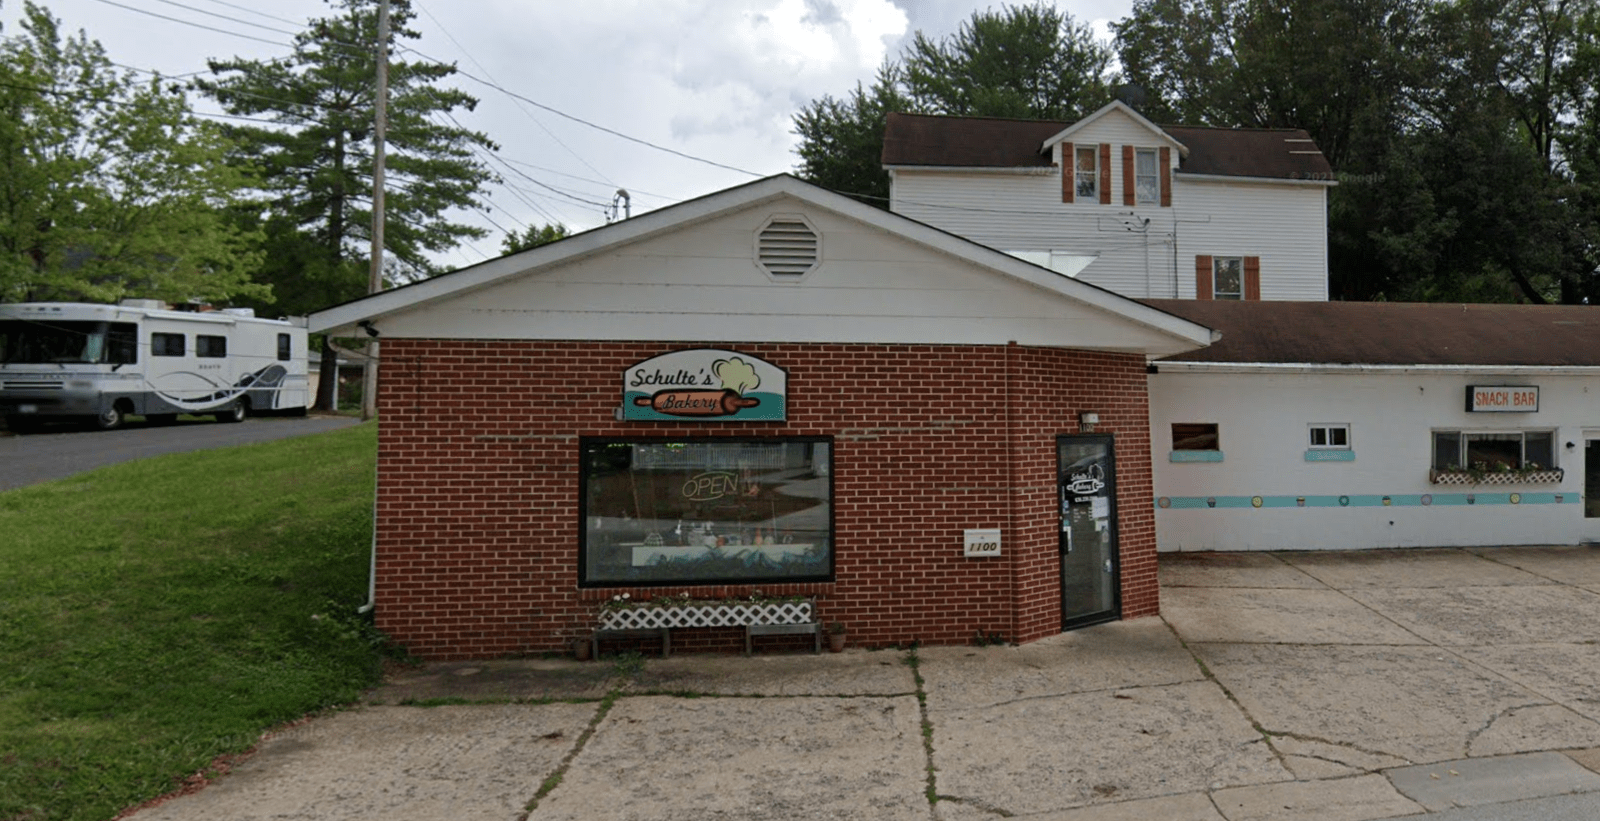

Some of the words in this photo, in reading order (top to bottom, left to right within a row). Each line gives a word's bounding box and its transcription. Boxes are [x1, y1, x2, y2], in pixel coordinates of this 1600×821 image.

[630, 368, 714, 387] Schulte's
[662, 394, 718, 411] Bakery
[1475, 391, 1509, 406] SNACK
[1514, 391, 1536, 406] BAR
[682, 474, 739, 498] OPEN
[969, 542, 997, 552] 1100
